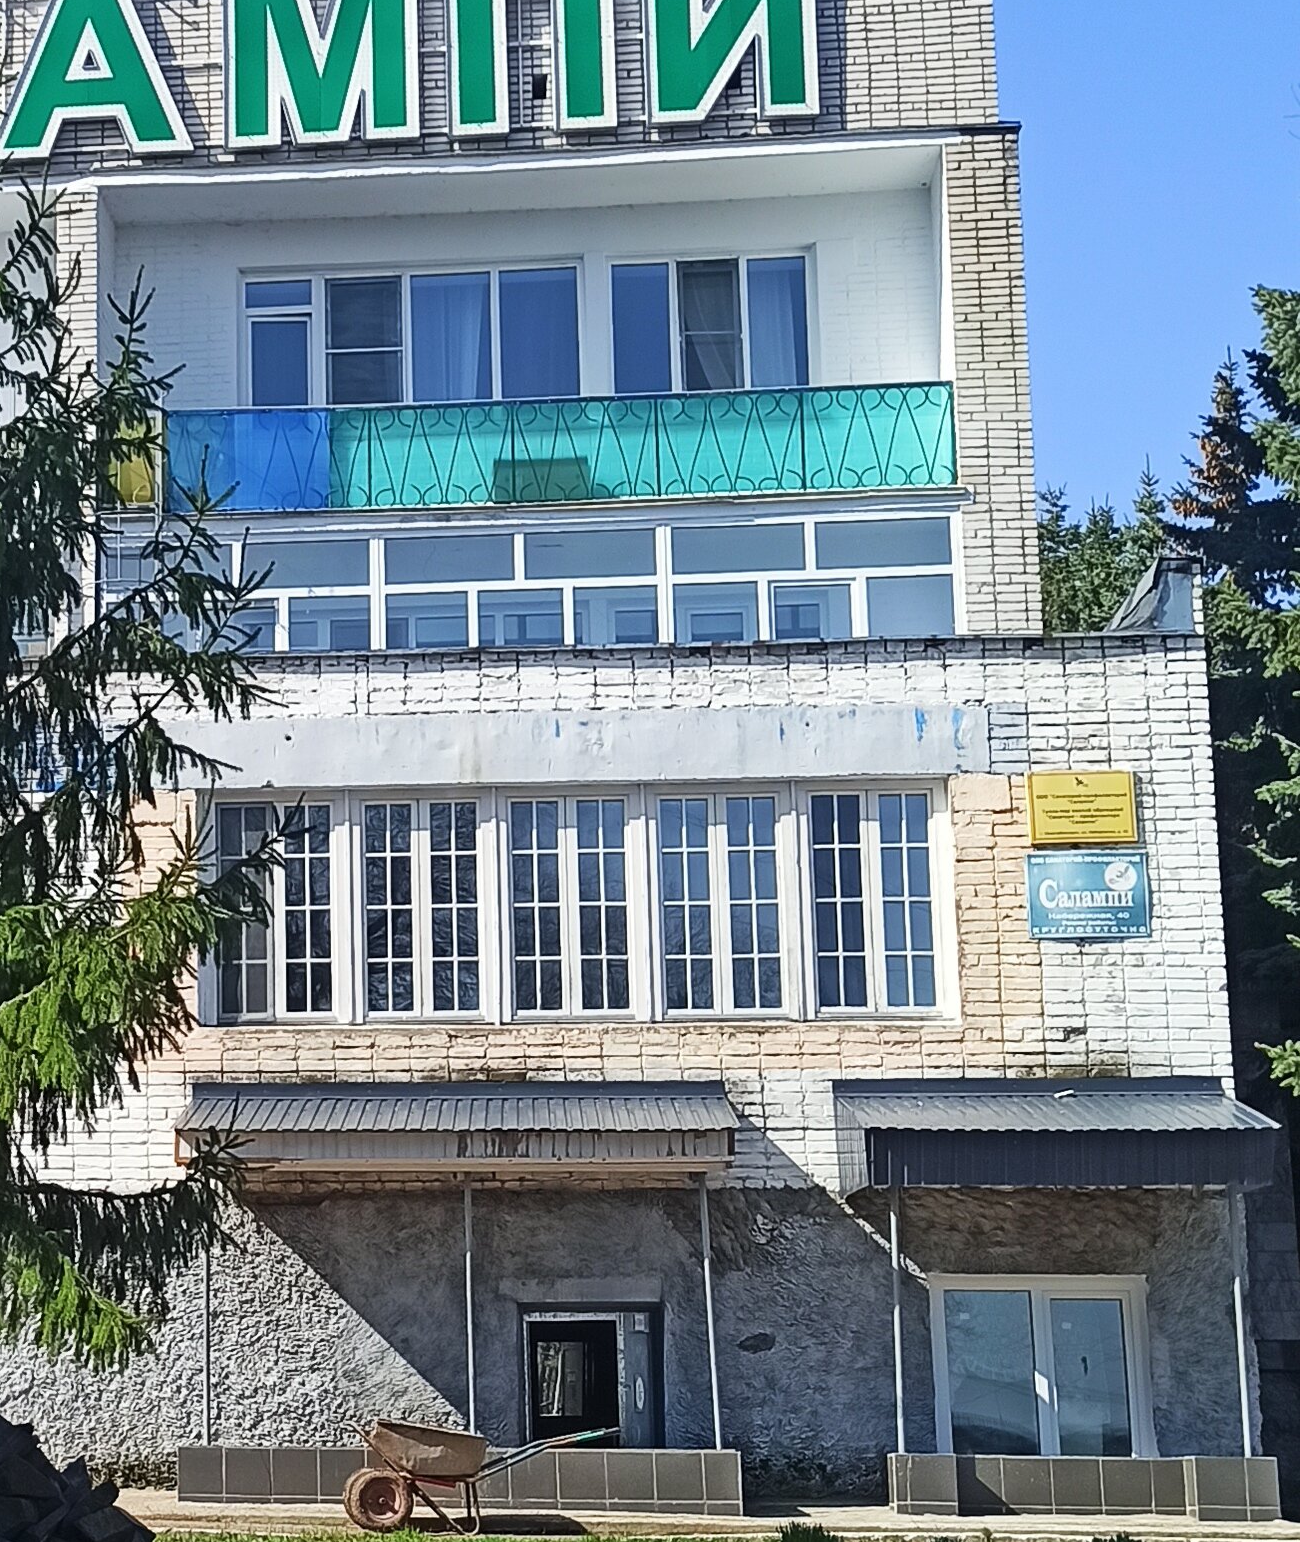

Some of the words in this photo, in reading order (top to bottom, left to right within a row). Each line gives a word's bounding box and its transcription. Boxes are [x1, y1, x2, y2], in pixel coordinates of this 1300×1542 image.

[1039, 879, 1134, 909] Салампи
[1116, 911, 1130, 919] 40
[1032, 925, 1147, 934] КРУГЛОСУТОЧНО
